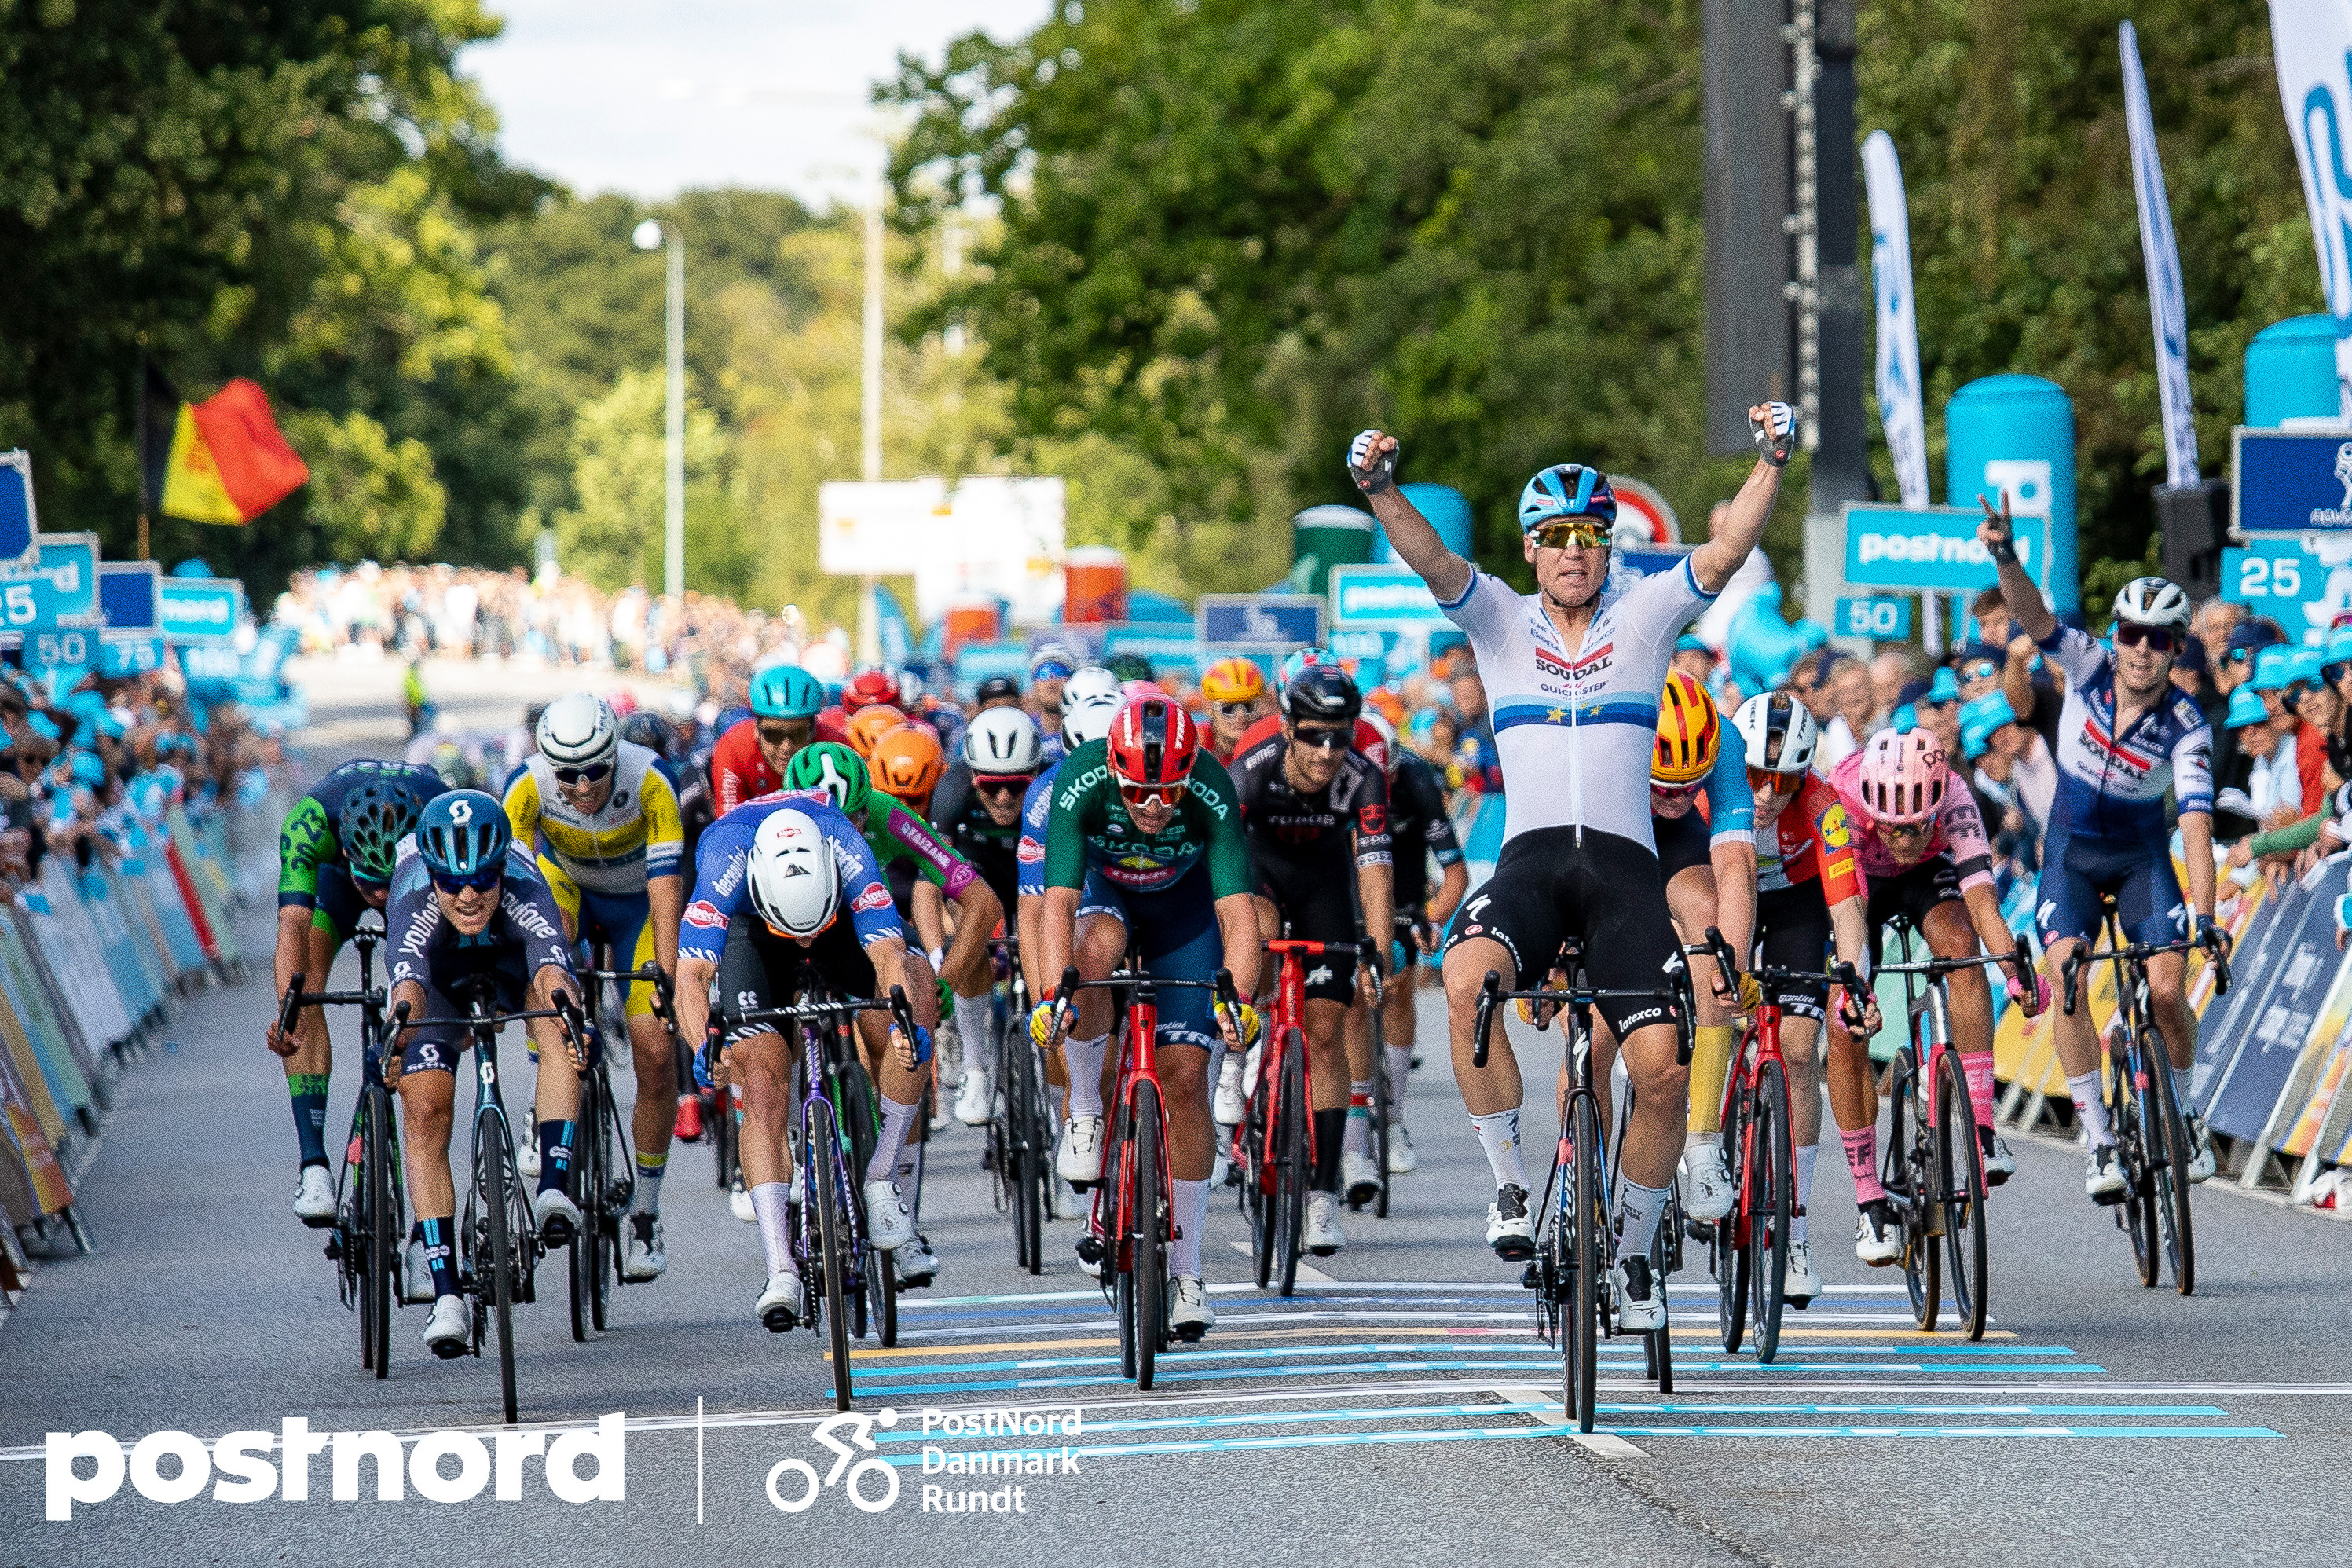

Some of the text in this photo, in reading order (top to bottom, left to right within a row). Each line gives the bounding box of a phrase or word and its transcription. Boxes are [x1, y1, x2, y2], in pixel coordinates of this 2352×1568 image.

[1859, 532, 2031, 565] postnod
[2240, 557, 2301, 596] 25
[0, 584, 37, 625] 5
[1851, 601, 1898, 634] 50
[38, 633, 86, 664] 50
[1535, 657, 1613, 680] SOUDAL
[1617, 1006, 1663, 1034] latexco
